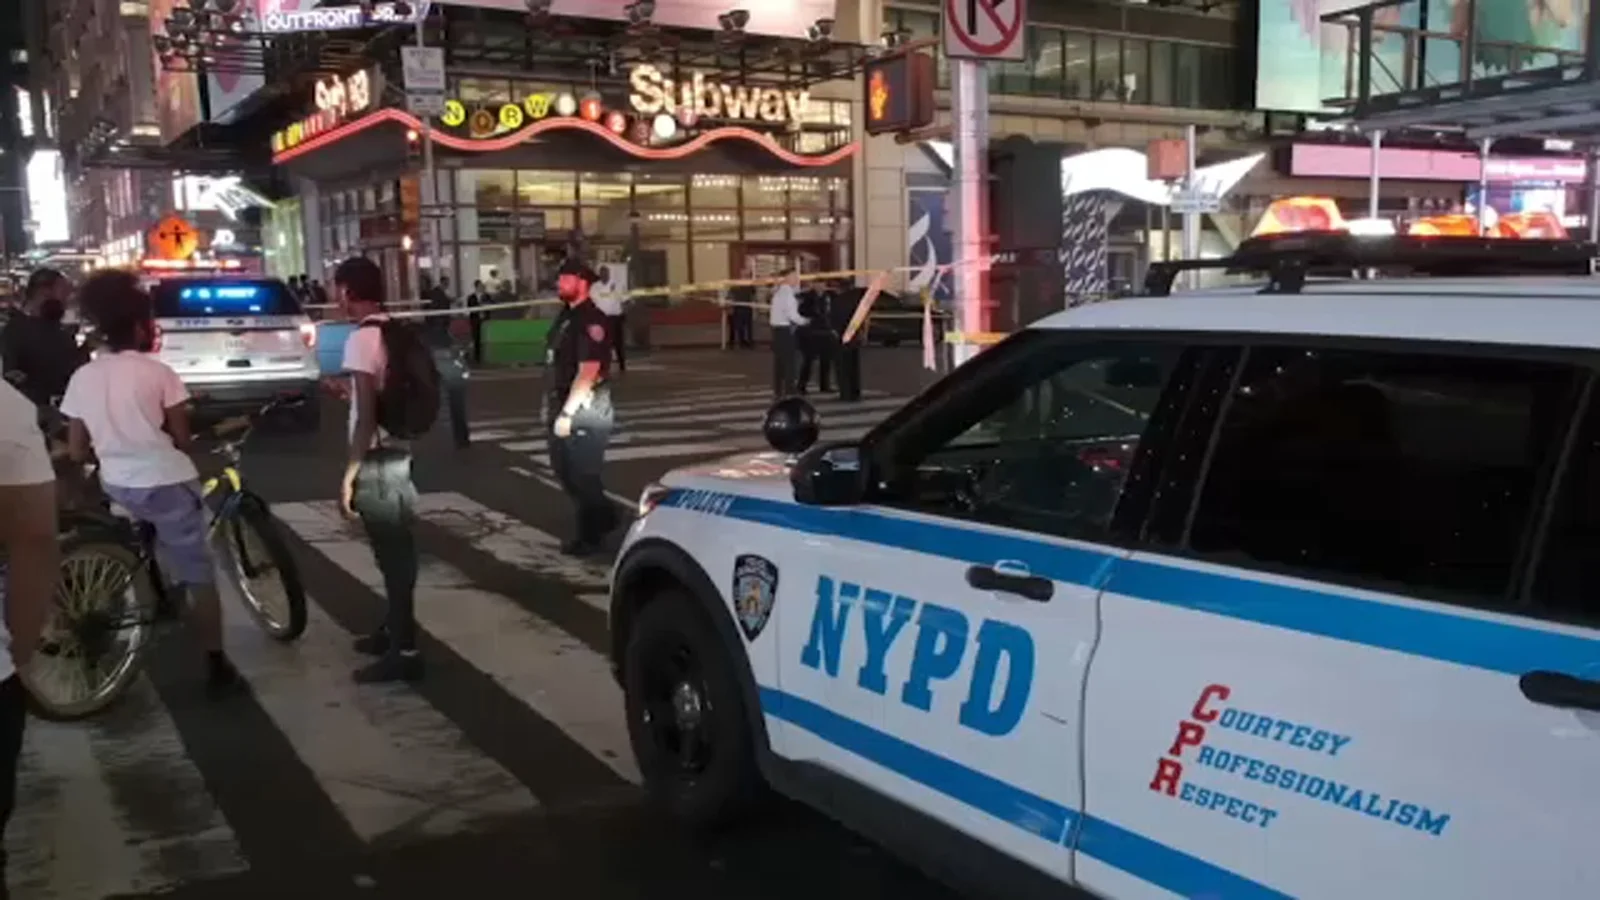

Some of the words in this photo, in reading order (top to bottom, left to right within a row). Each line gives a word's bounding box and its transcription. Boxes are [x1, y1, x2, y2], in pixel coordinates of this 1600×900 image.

[266, 9, 360, 30] OUTFRONT
[629, 64, 810, 131] Subway
[676, 490, 736, 516] POLICE
[801, 575, 1035, 737] NYPD
[1191, 684, 1350, 756] COURTESY
[1149, 757, 1278, 829] RESPECT
[1169, 720, 1450, 836] PROFESSIONALISM
